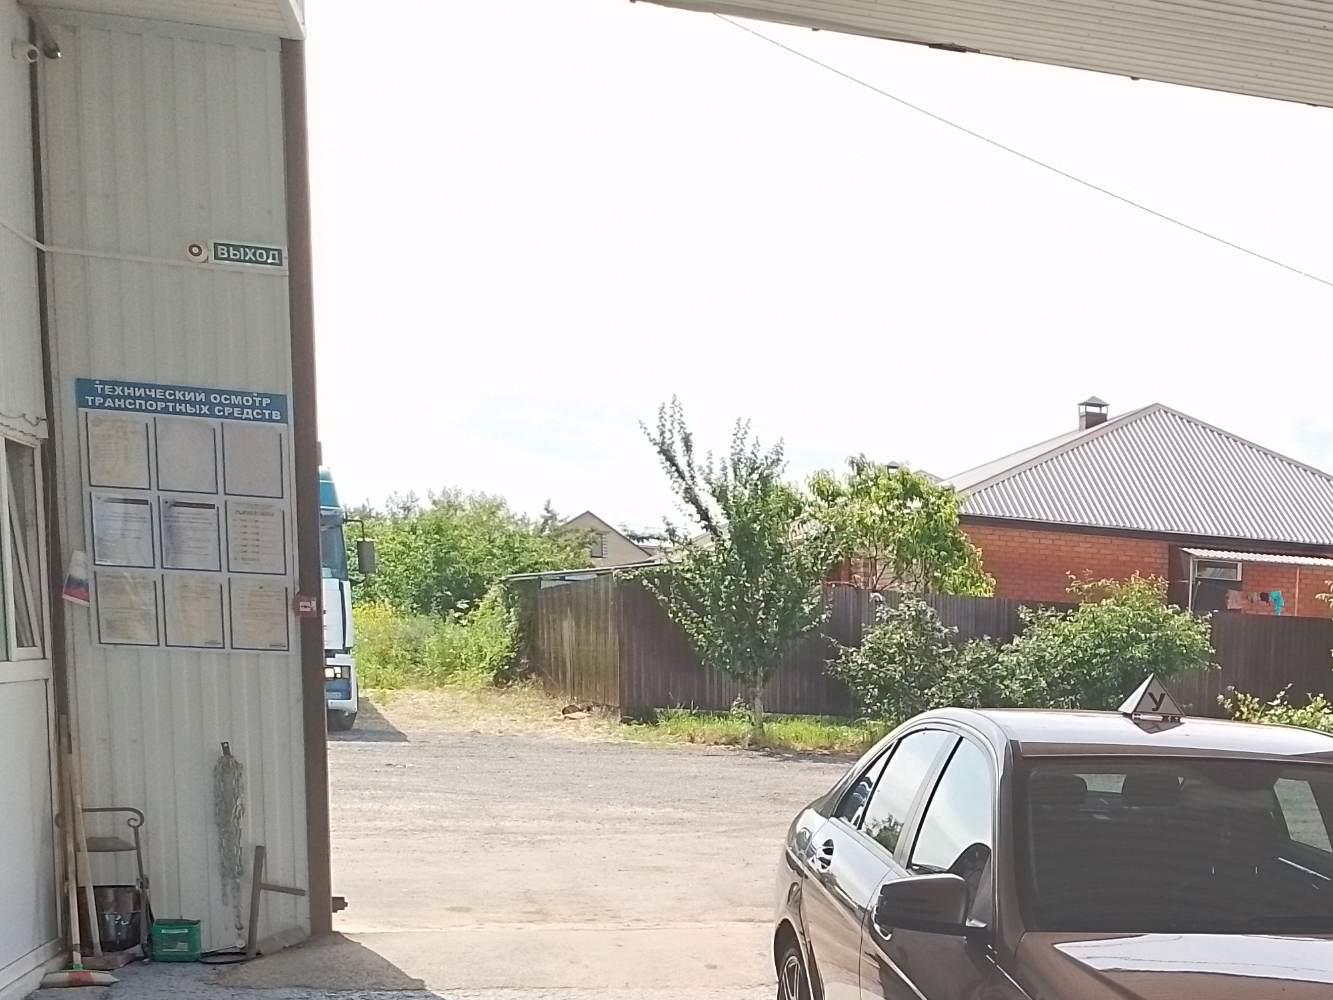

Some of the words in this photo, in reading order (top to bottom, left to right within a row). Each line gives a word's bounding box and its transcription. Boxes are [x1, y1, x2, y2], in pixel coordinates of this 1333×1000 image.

[217, 245, 280, 264] ВЫХОД
[94, 384, 206, 402] ТЕХНИЧЕСКИЙ
[210, 393, 271, 407] ОСМОТР
[85, 396, 210, 415] ТРАНСПОРТНЫХ
[214, 406, 281, 420] СРЕДСТВ
